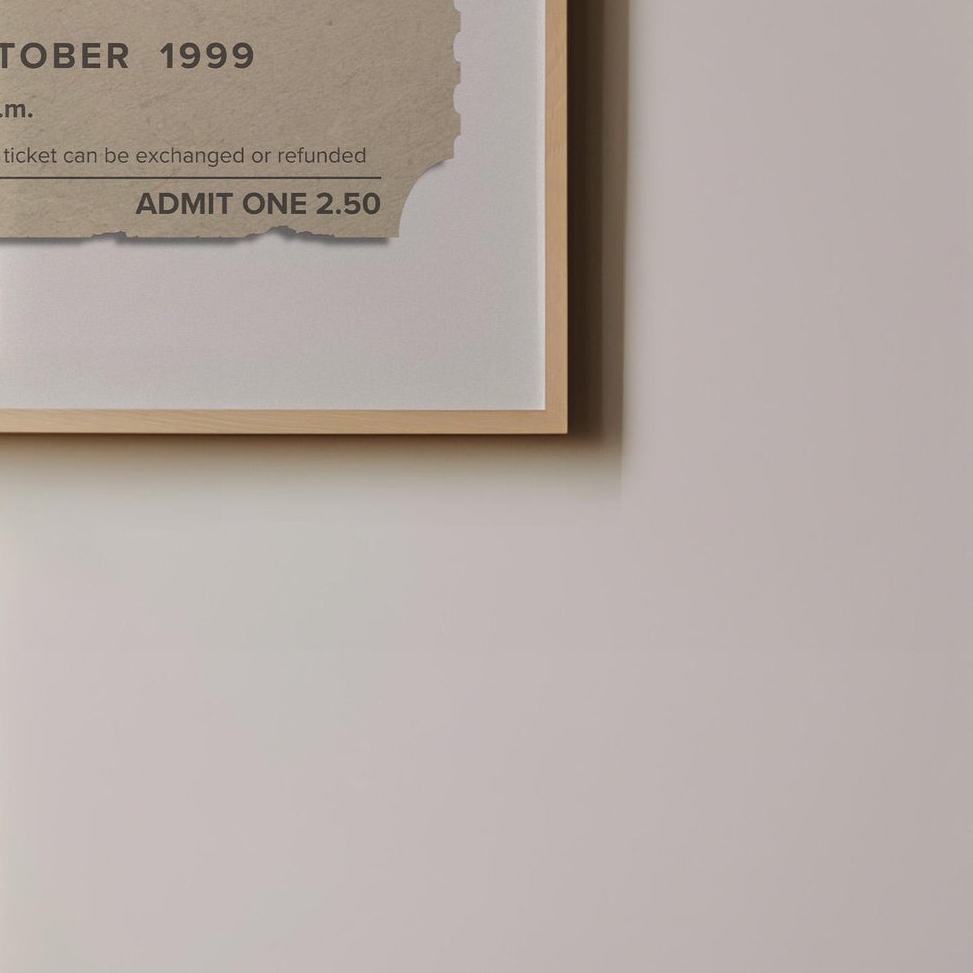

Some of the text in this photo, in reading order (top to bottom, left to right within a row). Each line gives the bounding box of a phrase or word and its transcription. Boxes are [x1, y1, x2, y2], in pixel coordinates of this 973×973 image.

[159, 41, 254, 70] 1999
[2, 146, 58, 164] ticket
[63, 150, 98, 164] can
[104, 146, 130, 164] be
[135, 146, 245, 168] exchanged
[251, 150, 272, 164] or
[277, 146, 367, 164] refunded
[134, 191, 381, 215] ADMIT ONE 2.50
